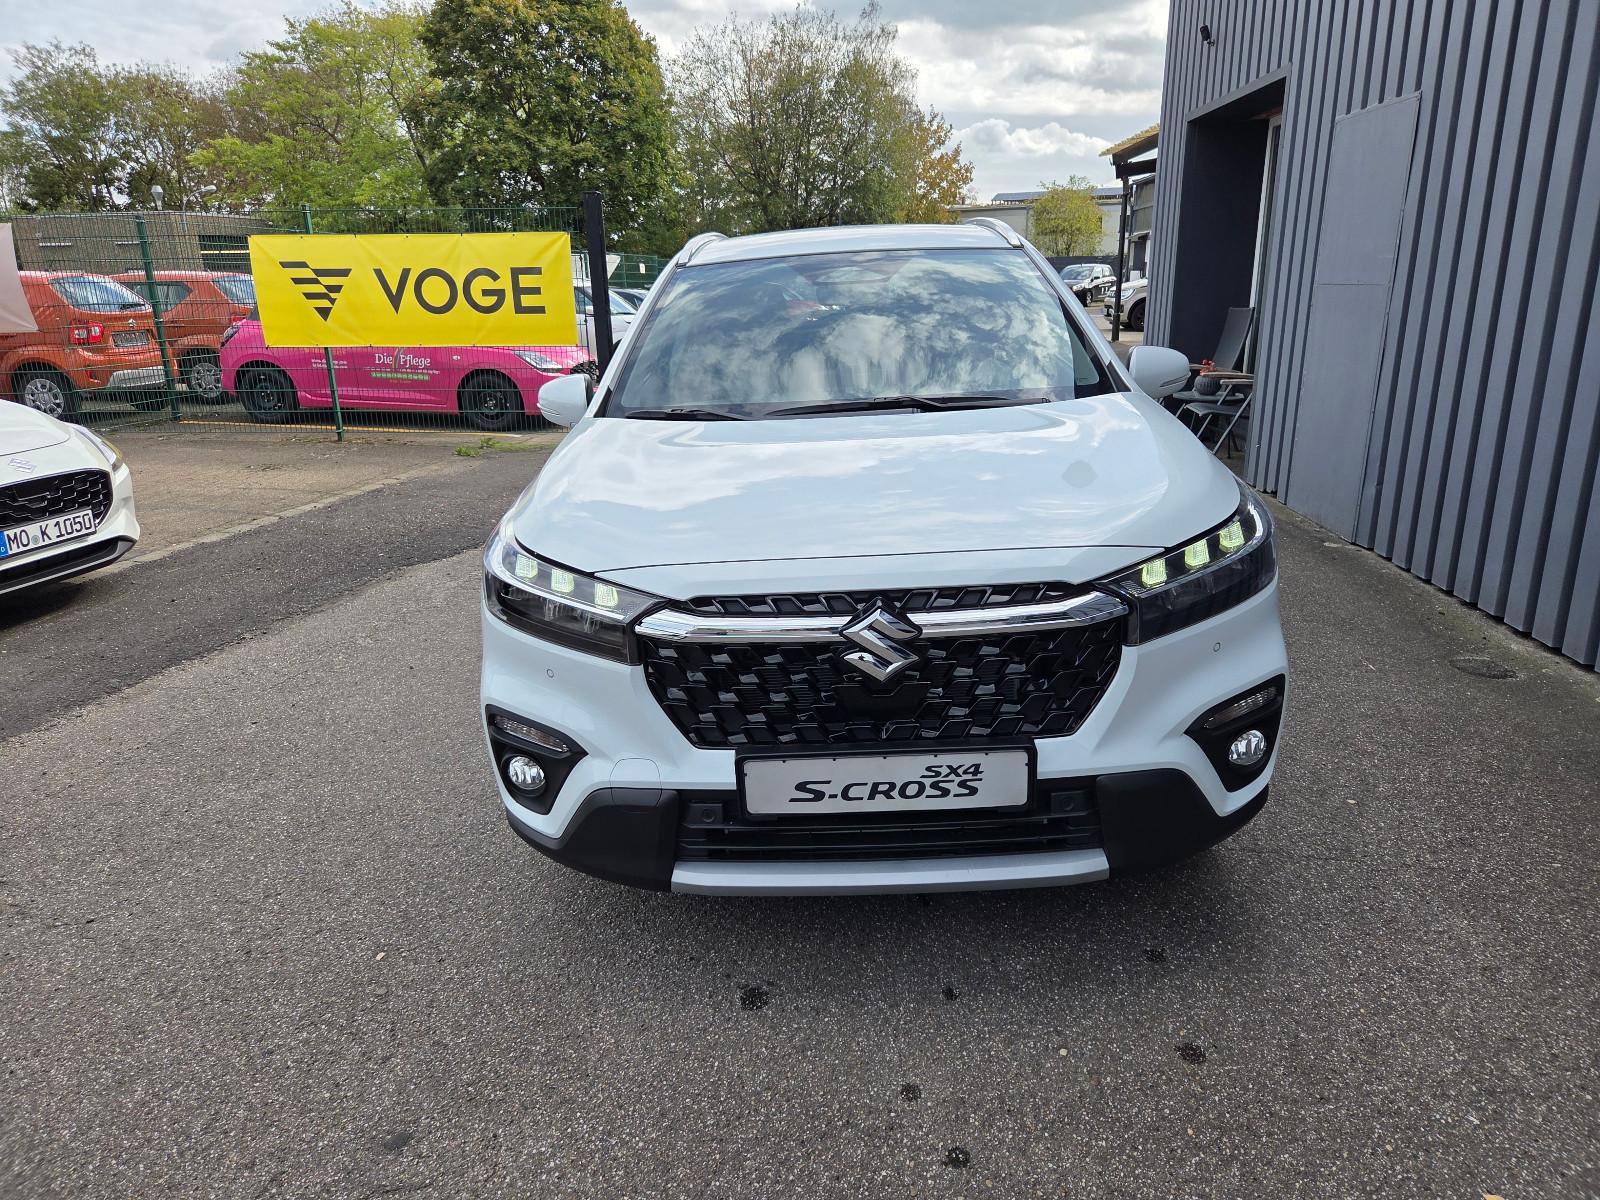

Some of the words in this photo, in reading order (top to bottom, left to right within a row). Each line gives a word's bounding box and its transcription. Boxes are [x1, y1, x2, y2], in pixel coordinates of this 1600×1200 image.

[373, 266, 546, 315] VOGE
[375, 353, 393, 364] Die
[400, 354, 431, 368] Pflege
[6, 529, 30, 550] MO
[40, 524, 52, 542] K
[54, 513, 93, 539] 1050
[920, 763, 984, 779] SX4
[789, 778, 983, 803] S-CROSS
